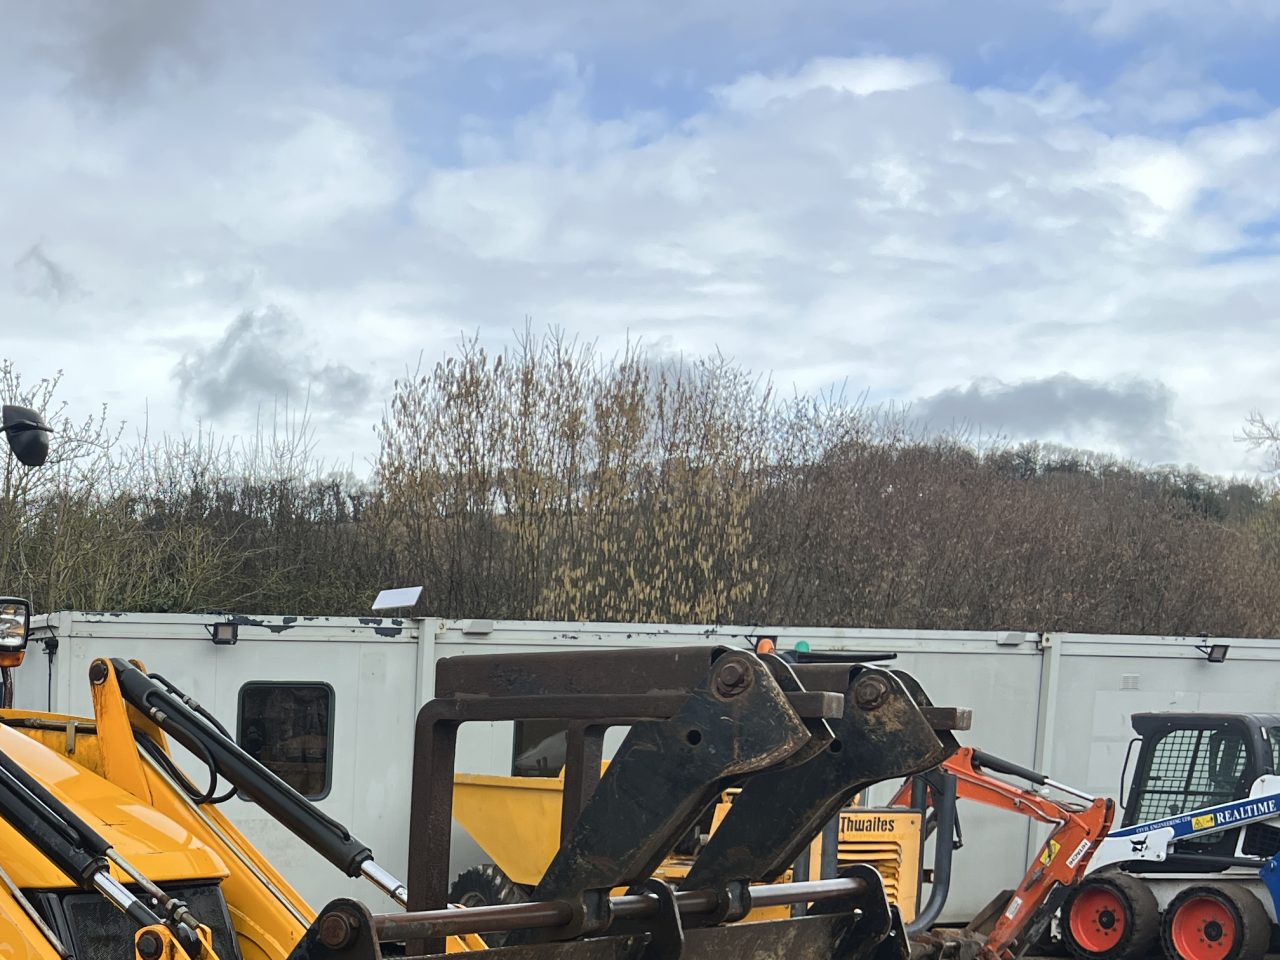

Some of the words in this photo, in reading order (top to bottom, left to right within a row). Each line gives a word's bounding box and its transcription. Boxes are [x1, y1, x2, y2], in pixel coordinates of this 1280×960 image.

[1216, 799, 1277, 824] REALTIME
[840, 816, 895, 833] Thwaites
[1150, 818, 1182, 831] ENGINEERING
[1067, 841, 1089, 866] HITACHI
